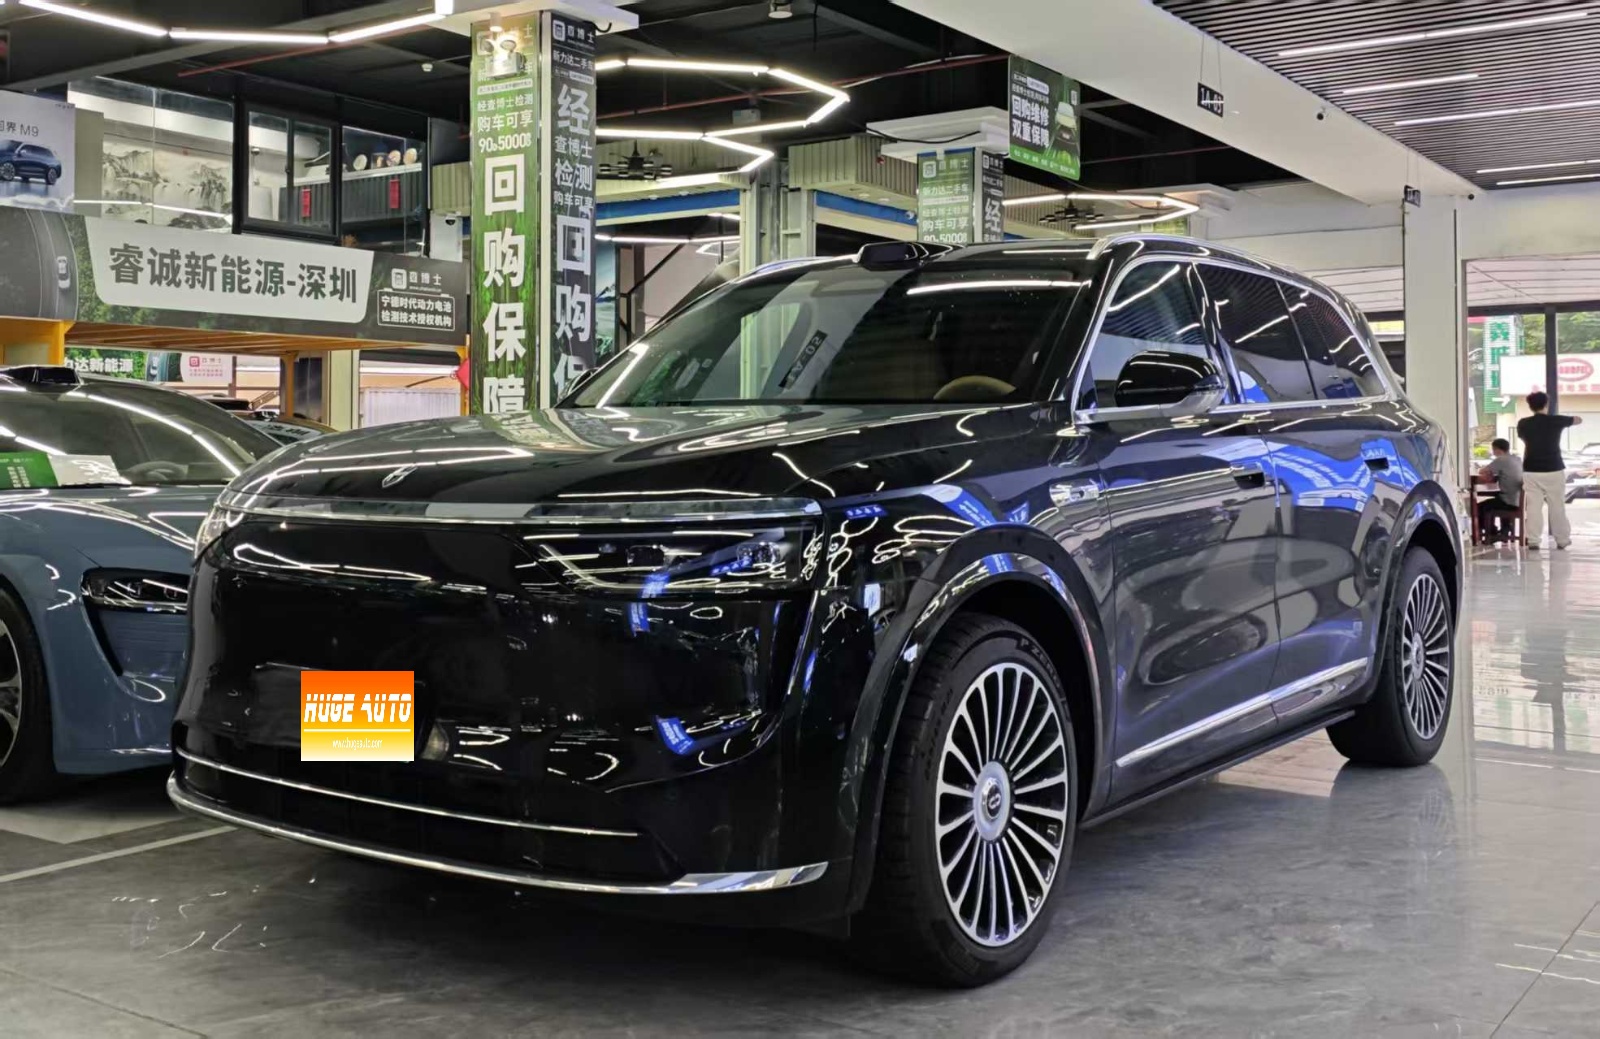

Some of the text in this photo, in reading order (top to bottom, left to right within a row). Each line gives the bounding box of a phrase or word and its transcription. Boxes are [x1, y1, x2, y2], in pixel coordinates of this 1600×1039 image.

[477, 94, 533, 112] 经查博士检测
[557, 84, 590, 136] 经
[20, 124, 39, 137] M9
[477, 109, 533, 133] 购车可享
[554, 135, 593, 159] 查博士
[554, 158, 593, 191] 检测
[553, 191, 594, 210] 购车可享
[984, 198, 1001, 233] 经
[109, 243, 357, 304] 睿诚新能源-深圳
[381, 295, 452, 313] 宁德时代动力电池
[381, 310, 452, 327] 检测技术授权机构
